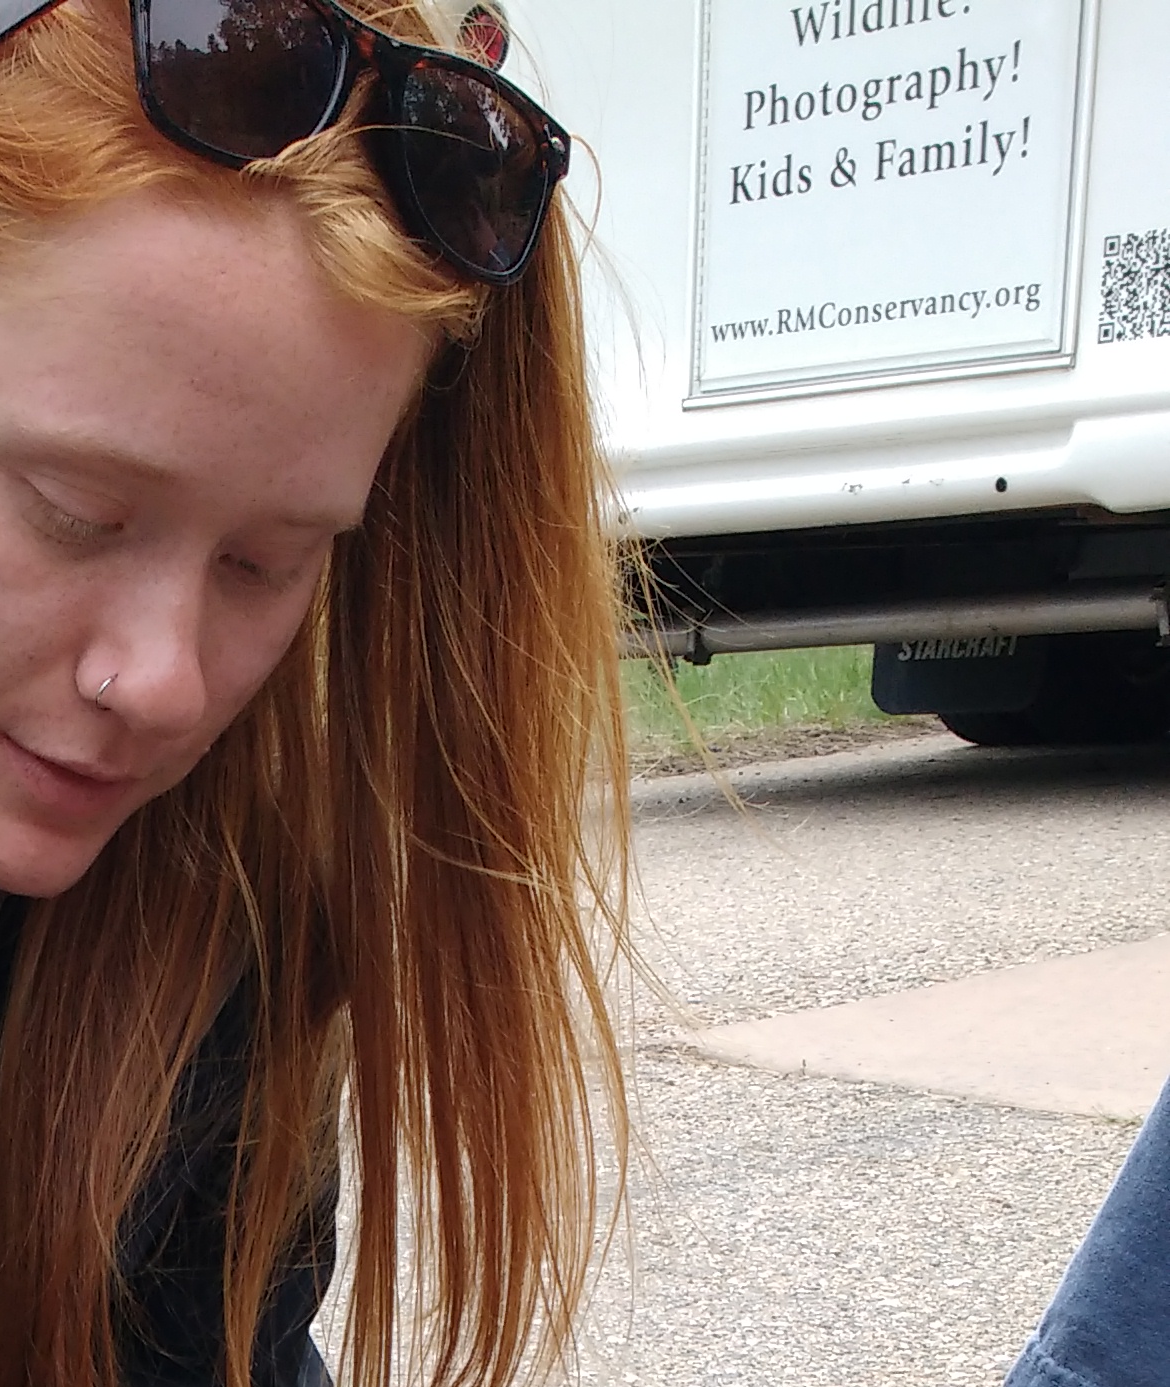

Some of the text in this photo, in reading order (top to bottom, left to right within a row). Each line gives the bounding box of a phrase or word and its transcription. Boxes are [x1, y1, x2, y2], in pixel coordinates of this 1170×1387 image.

[743, 39, 1022, 131] Photography!
[729, 115, 1031, 205] Kids & Family!
[711, 282, 1042, 343] www.RMConservancy.org
